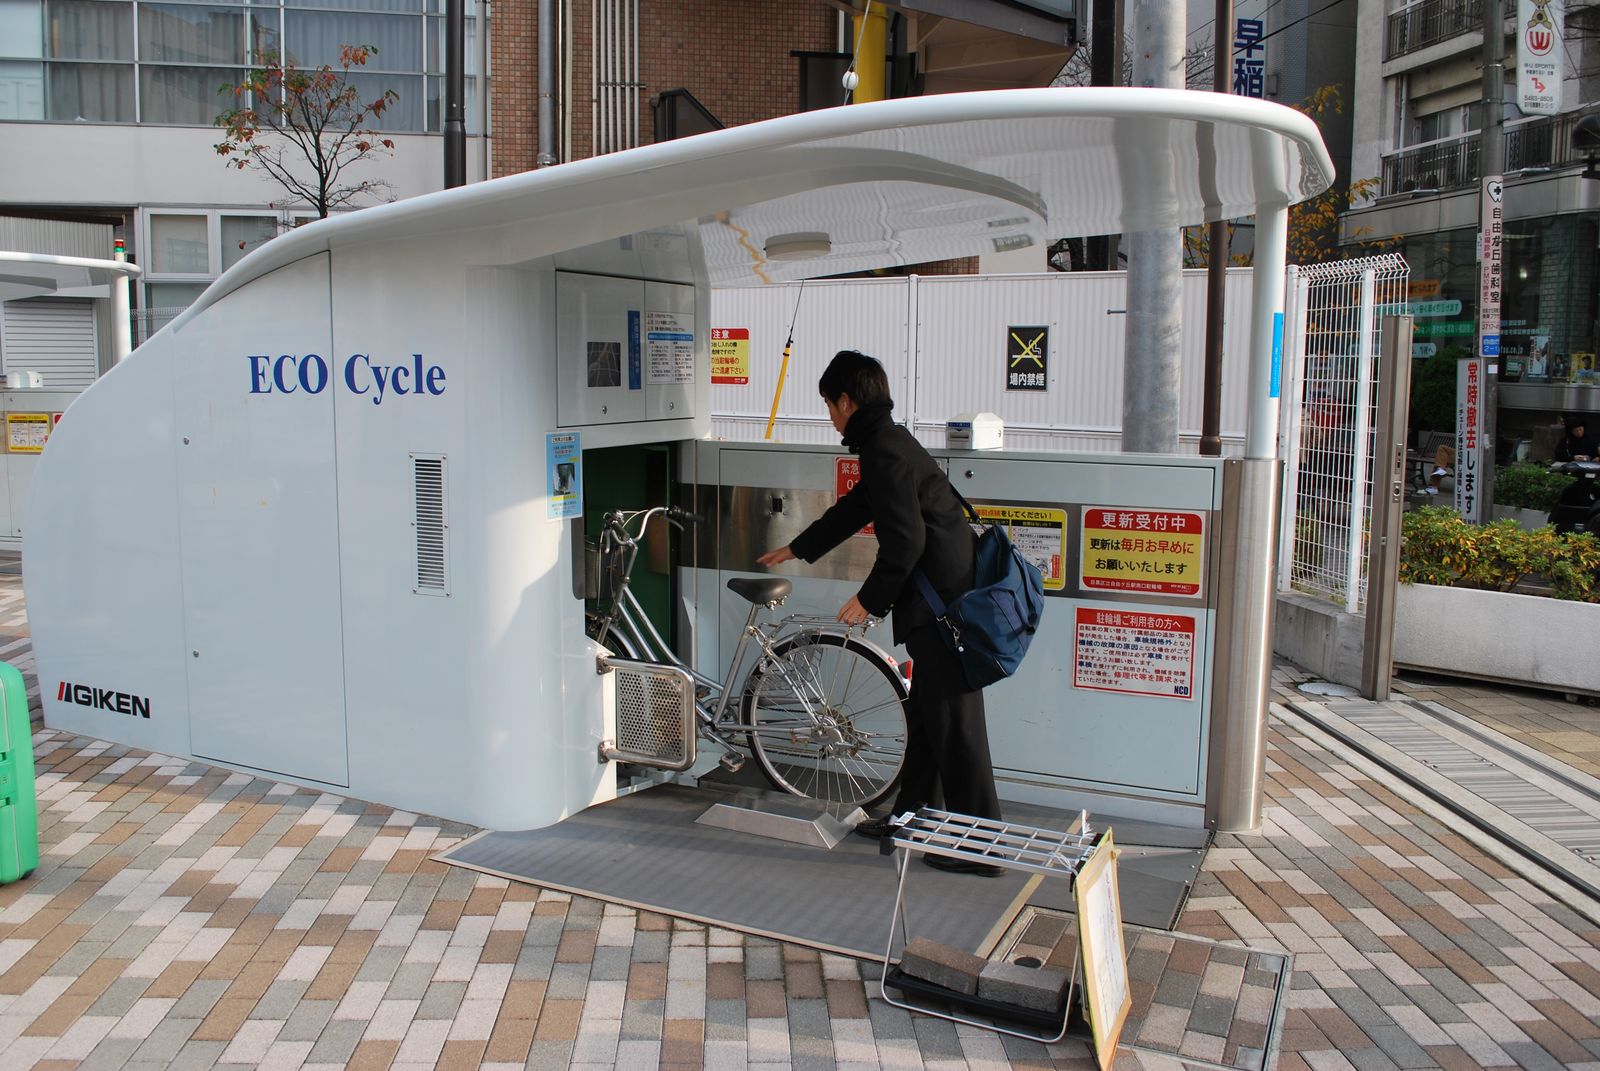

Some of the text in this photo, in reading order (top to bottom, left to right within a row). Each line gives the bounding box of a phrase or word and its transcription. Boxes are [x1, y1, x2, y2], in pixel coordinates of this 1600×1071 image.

[712, 329, 730, 339] 注意
[247, 354, 446, 405] ECO Cycle
[1009, 372, 1045, 386] 場内禁煙
[1465, 362, 1478, 514] 常時撤去します
[1101, 512, 1186, 532] 更新受付中
[1089, 537, 1195, 555] 更新は毎月お早めに
[1095, 558, 1188, 575] お願いいたします
[1096, 612, 1182, 630] 駐輪場ご利用者の方へ
[1173, 685, 1189, 696] NCD
[73, 684, 151, 719] GIKEN
